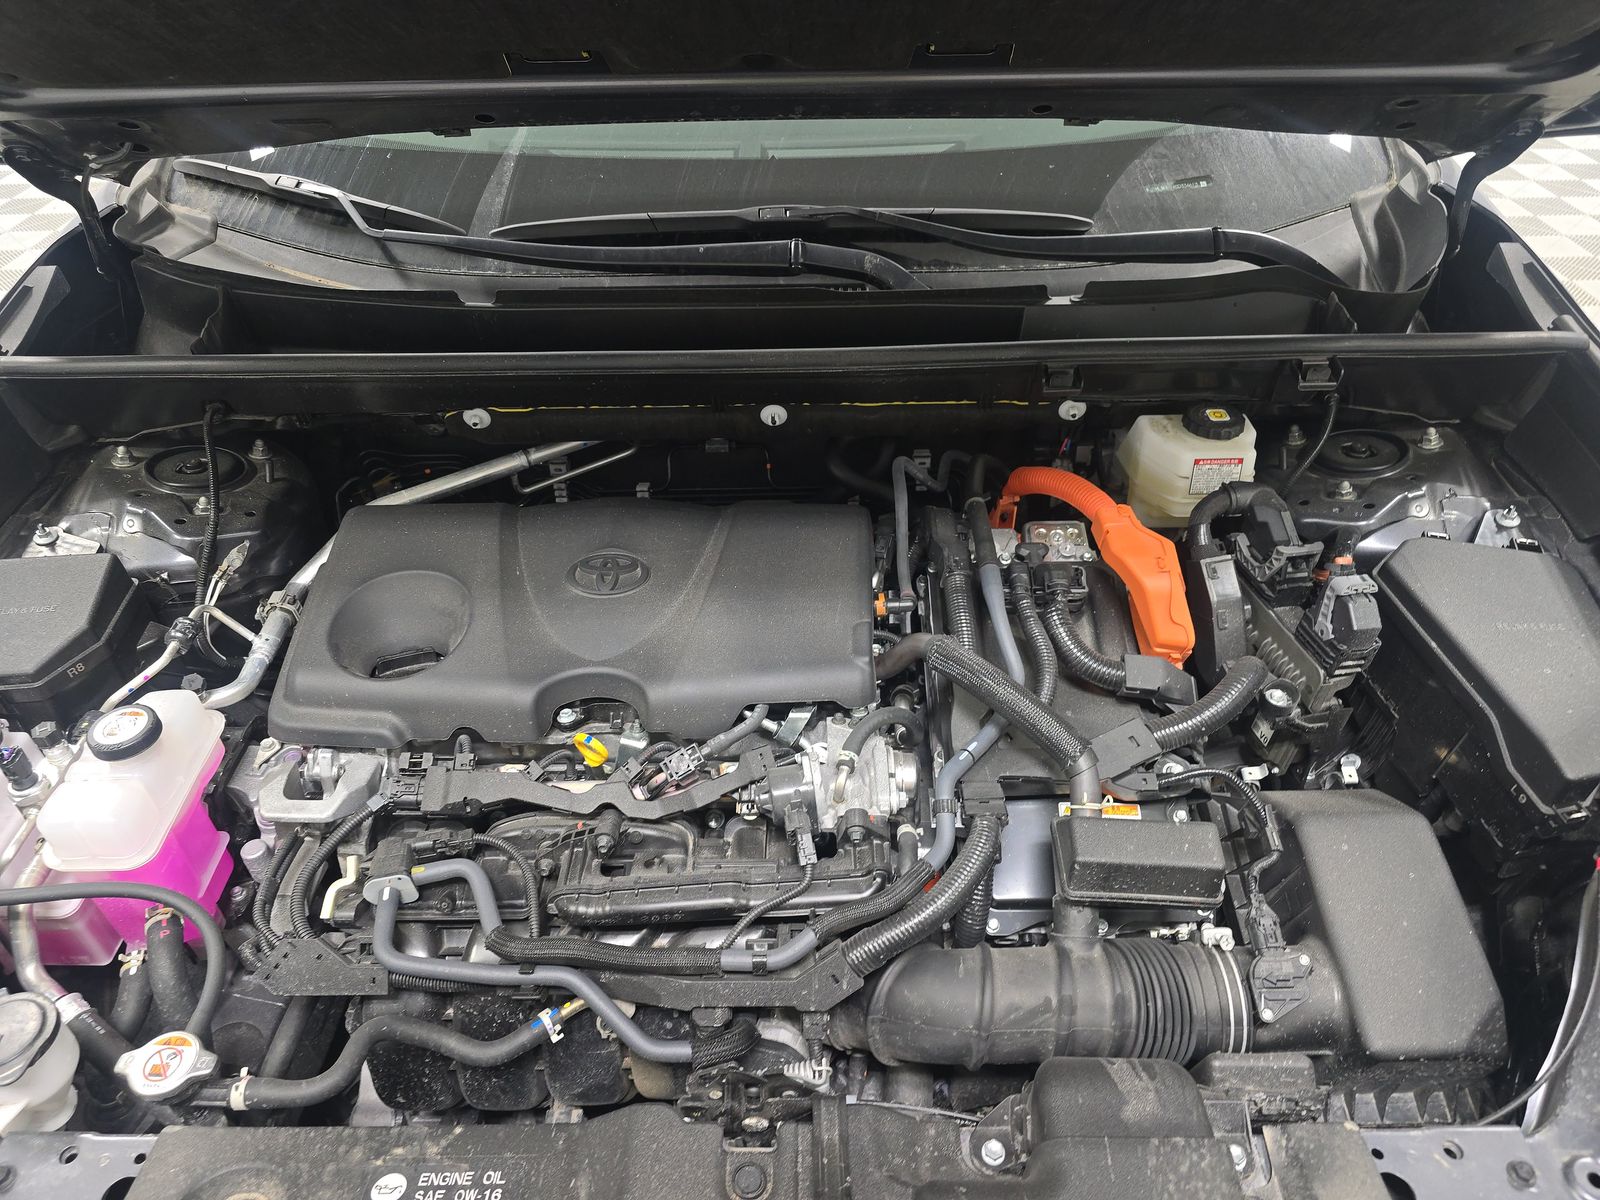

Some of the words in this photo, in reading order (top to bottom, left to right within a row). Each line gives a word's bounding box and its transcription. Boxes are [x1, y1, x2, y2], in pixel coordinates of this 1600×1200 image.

[66, 662, 86, 678] R8
[417, 1171, 475, 1187] ENGINE
[482, 1170, 507, 1186] OIL
